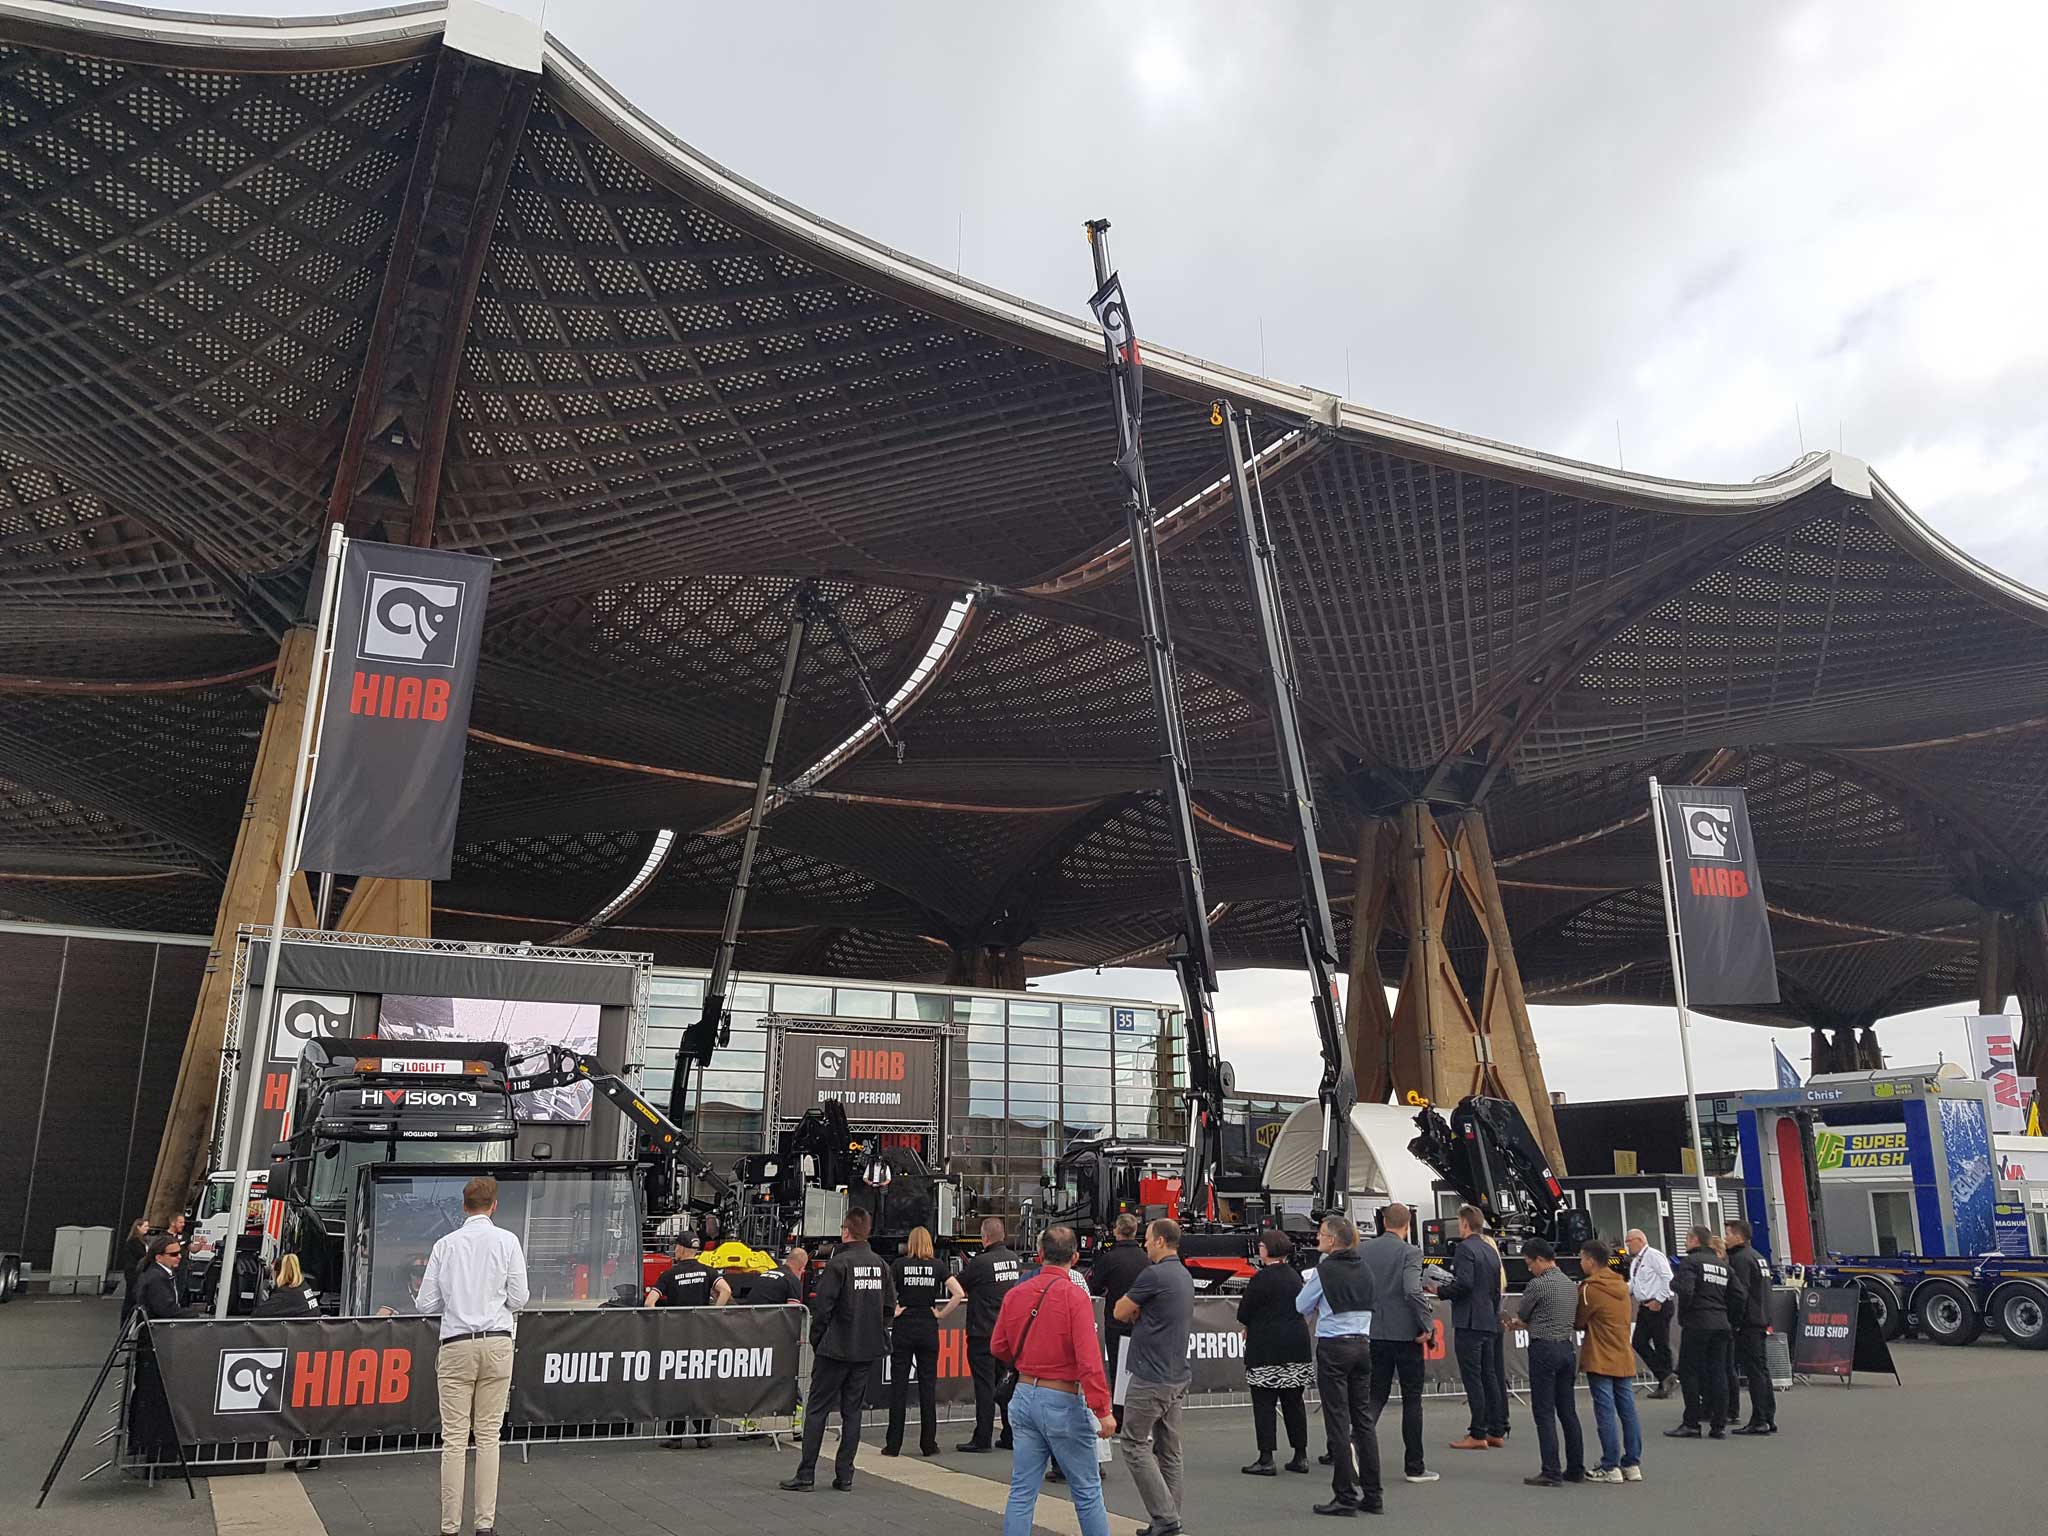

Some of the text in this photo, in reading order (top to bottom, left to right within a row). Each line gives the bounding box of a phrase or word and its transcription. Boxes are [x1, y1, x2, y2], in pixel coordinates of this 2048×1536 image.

[351, 672, 450, 721] HIAB
[1690, 867, 1748, 898] HIAB
[1119, 1013, 1132, 1027] 35
[406, 1063, 446, 1072] LOGLIFT
[850, 1050, 905, 1080] HIAB
[361, 1089, 457, 1106] HiVision
[845, 1092, 856, 1103] TO
[859, 1092, 901, 1105] PERFORM
[1807, 1089, 1843, 1101] Christ
[1852, 1135, 1906, 1149] SUPER
[1850, 1153, 1905, 1166] WASH
[854, 1267, 881, 1276] BUILT TO
[904, 1266, 933, 1275] BUILT TO
[994, 1261, 1009, 1271] BUILT
[904, 1277, 935, 1286] PERFORM
[1805, 1326, 1849, 1338] CLUB SHOP
[1186, 1332, 1246, 1359] PERFOR
[544, 1347, 773, 1384] BUILT TO PERFORM
[291, 1348, 412, 1408] HIAB
